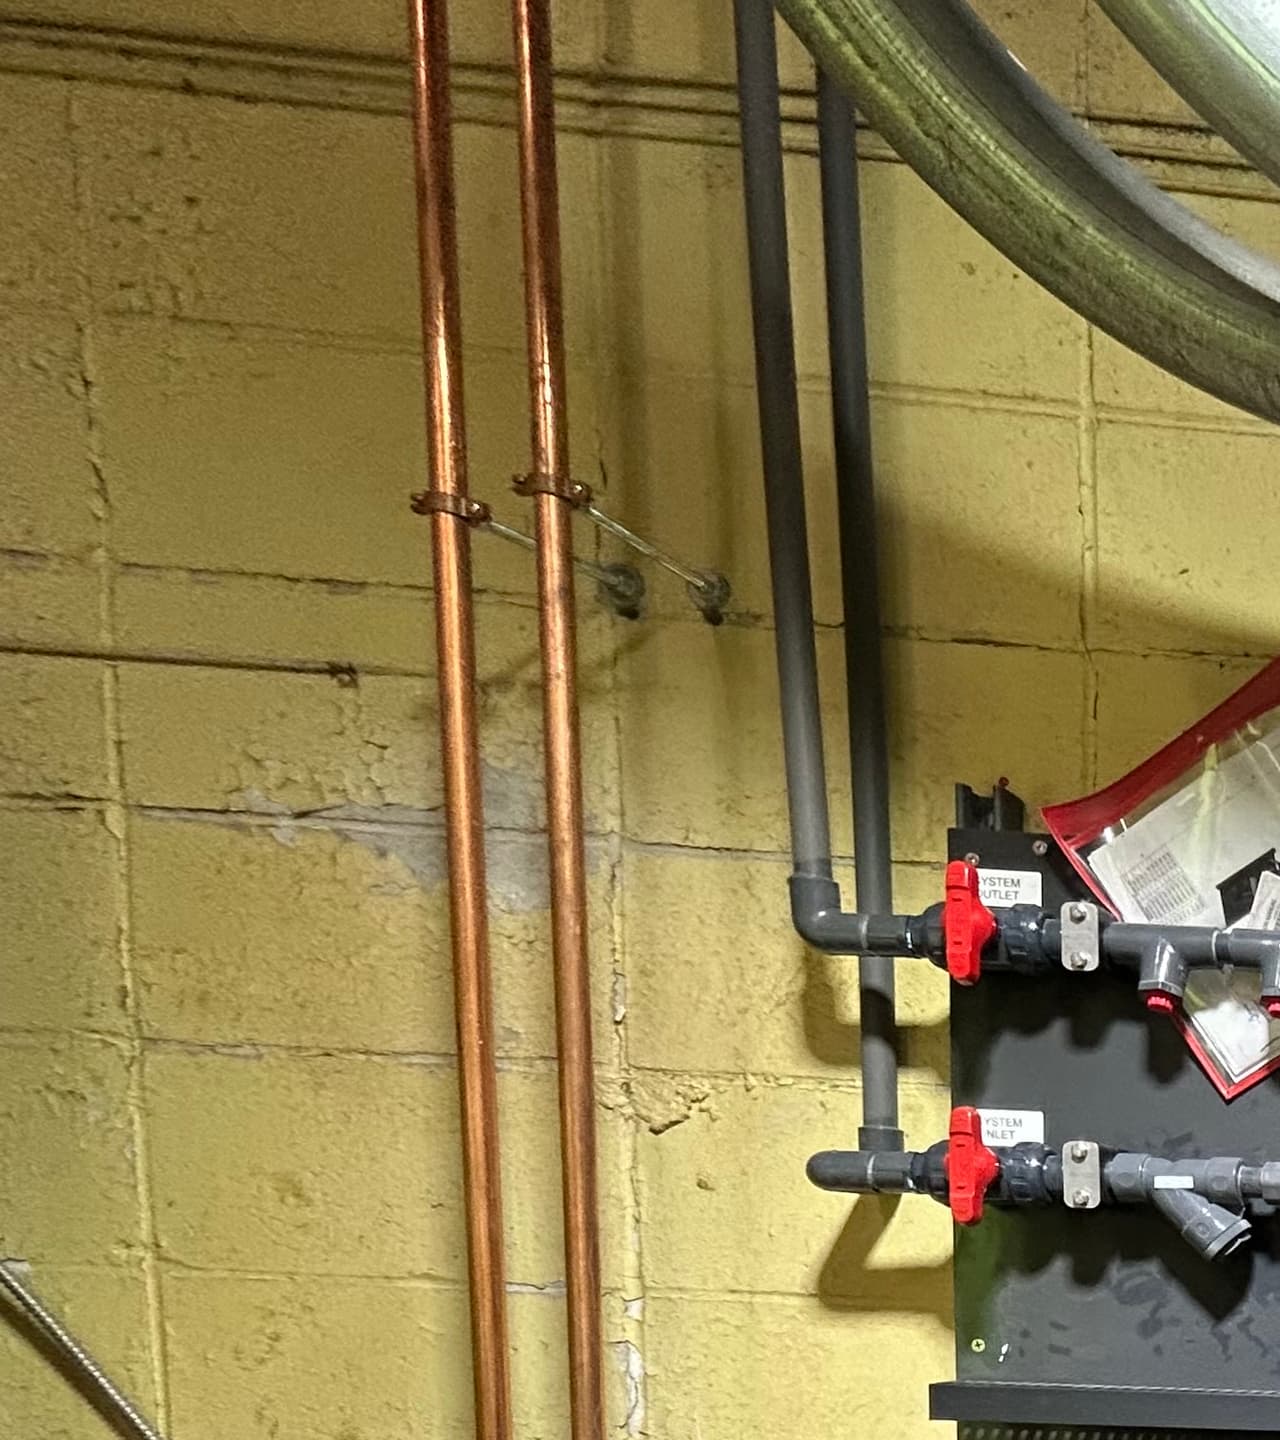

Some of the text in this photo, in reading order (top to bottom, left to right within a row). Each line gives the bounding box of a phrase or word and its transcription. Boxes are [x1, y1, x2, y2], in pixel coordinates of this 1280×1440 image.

[979, 877, 1021, 888] YSTEM
[985, 1117, 1023, 1128] YSTEM
[986, 1129, 1016, 1140] NLET
